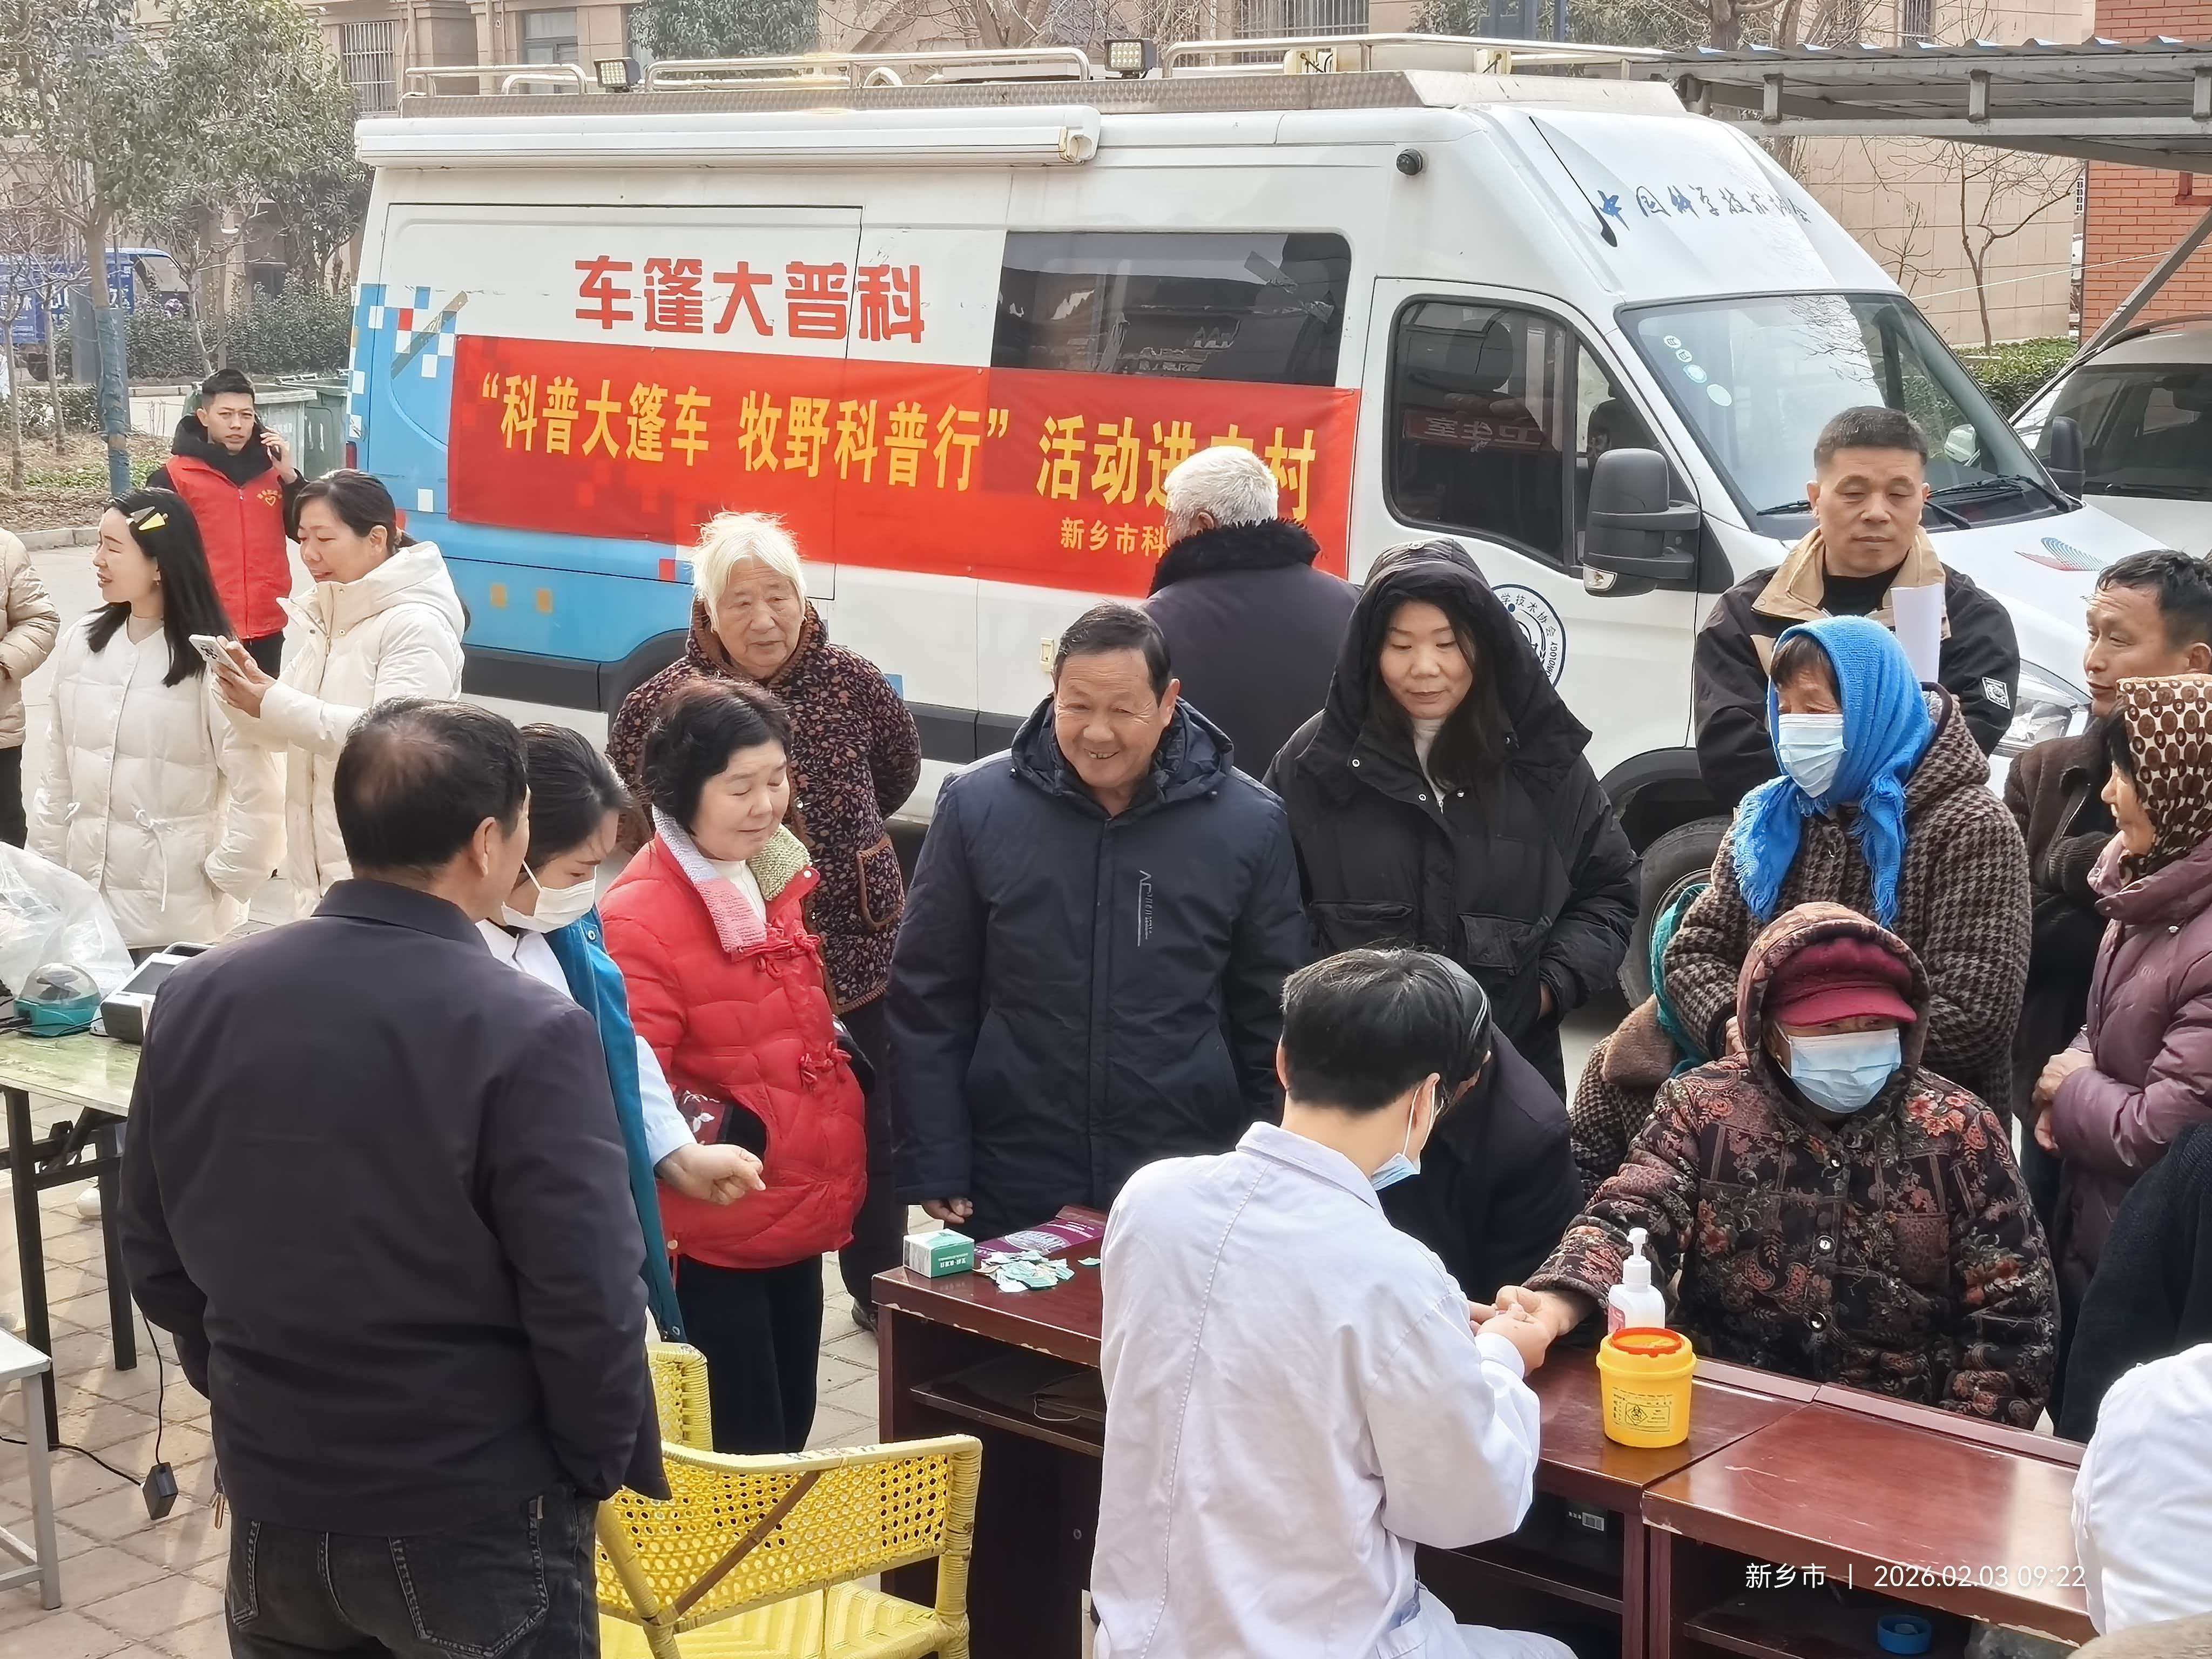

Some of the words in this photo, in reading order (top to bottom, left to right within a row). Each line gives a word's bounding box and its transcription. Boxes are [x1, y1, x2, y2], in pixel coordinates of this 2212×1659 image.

[482, 372, 712, 467] “科普大篷车
[738, 390, 1010, 491] 牧野科普行”
